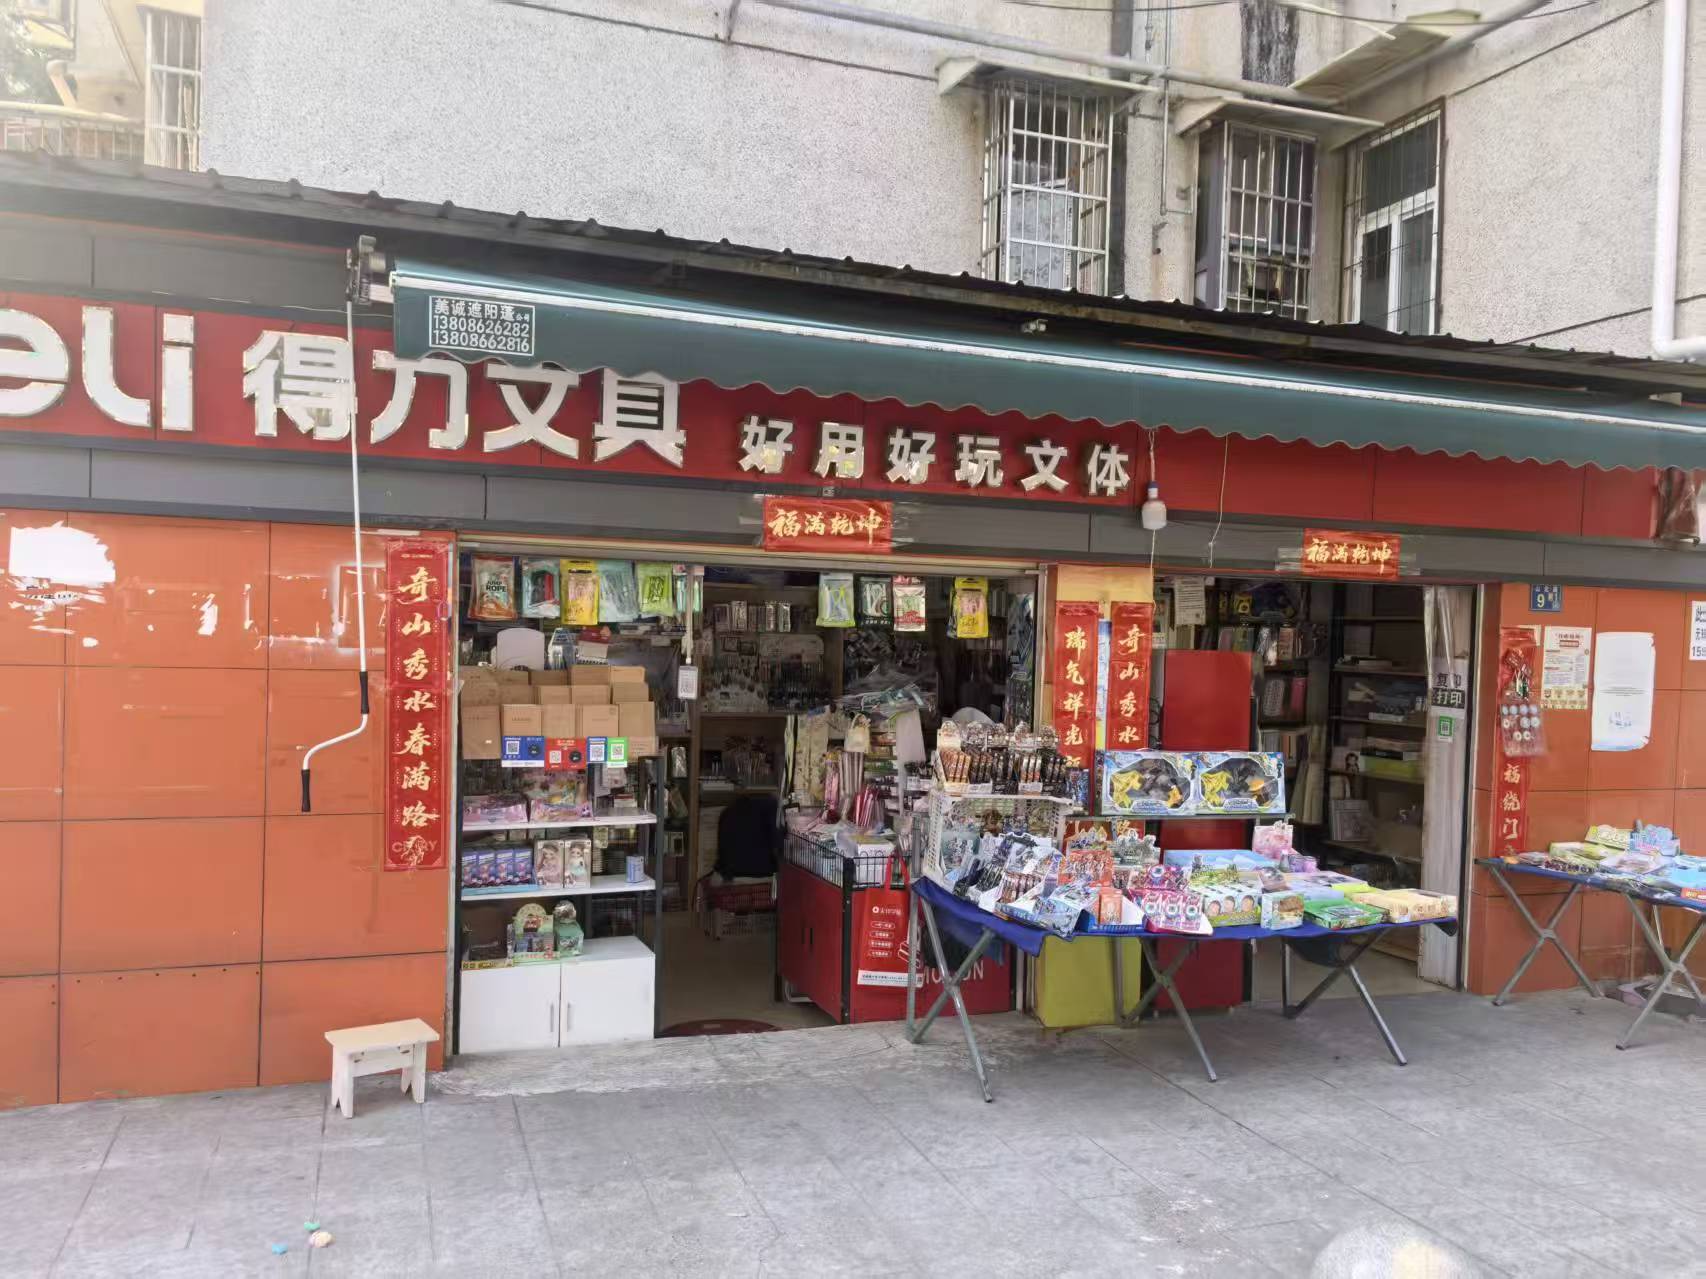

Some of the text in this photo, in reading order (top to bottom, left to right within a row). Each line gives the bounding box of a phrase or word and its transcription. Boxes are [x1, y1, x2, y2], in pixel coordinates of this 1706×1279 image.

[433, 315, 530, 337] 13808626282
[433, 330, 530, 352] 13808662816
[243, 330, 1131, 497] 得力文具 好用好玩文体
[768, 507, 884, 545] 福满乾坤
[1306, 537, 1393, 574] 福满乾坤
[486, 585, 507, 593] ROPE
[395, 566, 440, 827] 奇山秀水春满路
[1437, 689, 1462, 707] 打印
